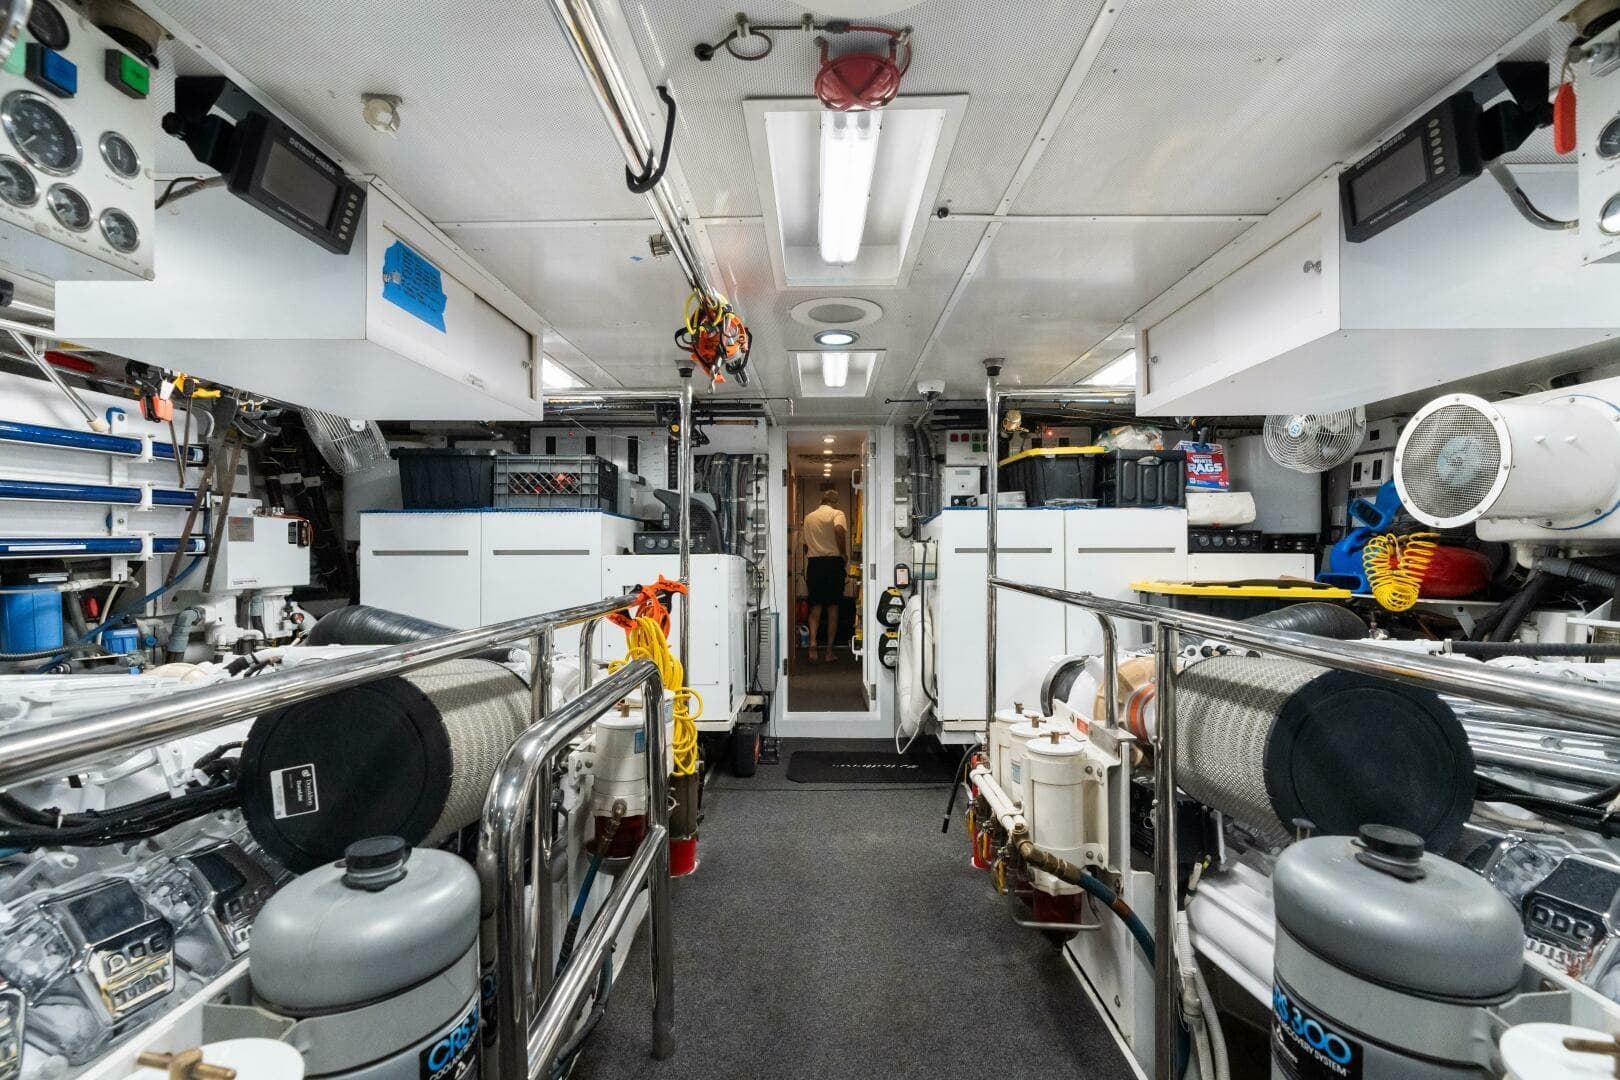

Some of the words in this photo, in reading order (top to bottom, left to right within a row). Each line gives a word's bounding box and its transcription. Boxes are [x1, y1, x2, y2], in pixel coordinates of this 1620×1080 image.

[289, 137, 315, 159] DETROIT
[1356, 148, 1382, 170] DETROIT
[1382, 132, 1407, 151] DIESEL
[1187, 463, 1223, 475] RAGS
[1291, 1007, 1352, 1064] 300
[1314, 1050, 1348, 1077] SYSTEM
